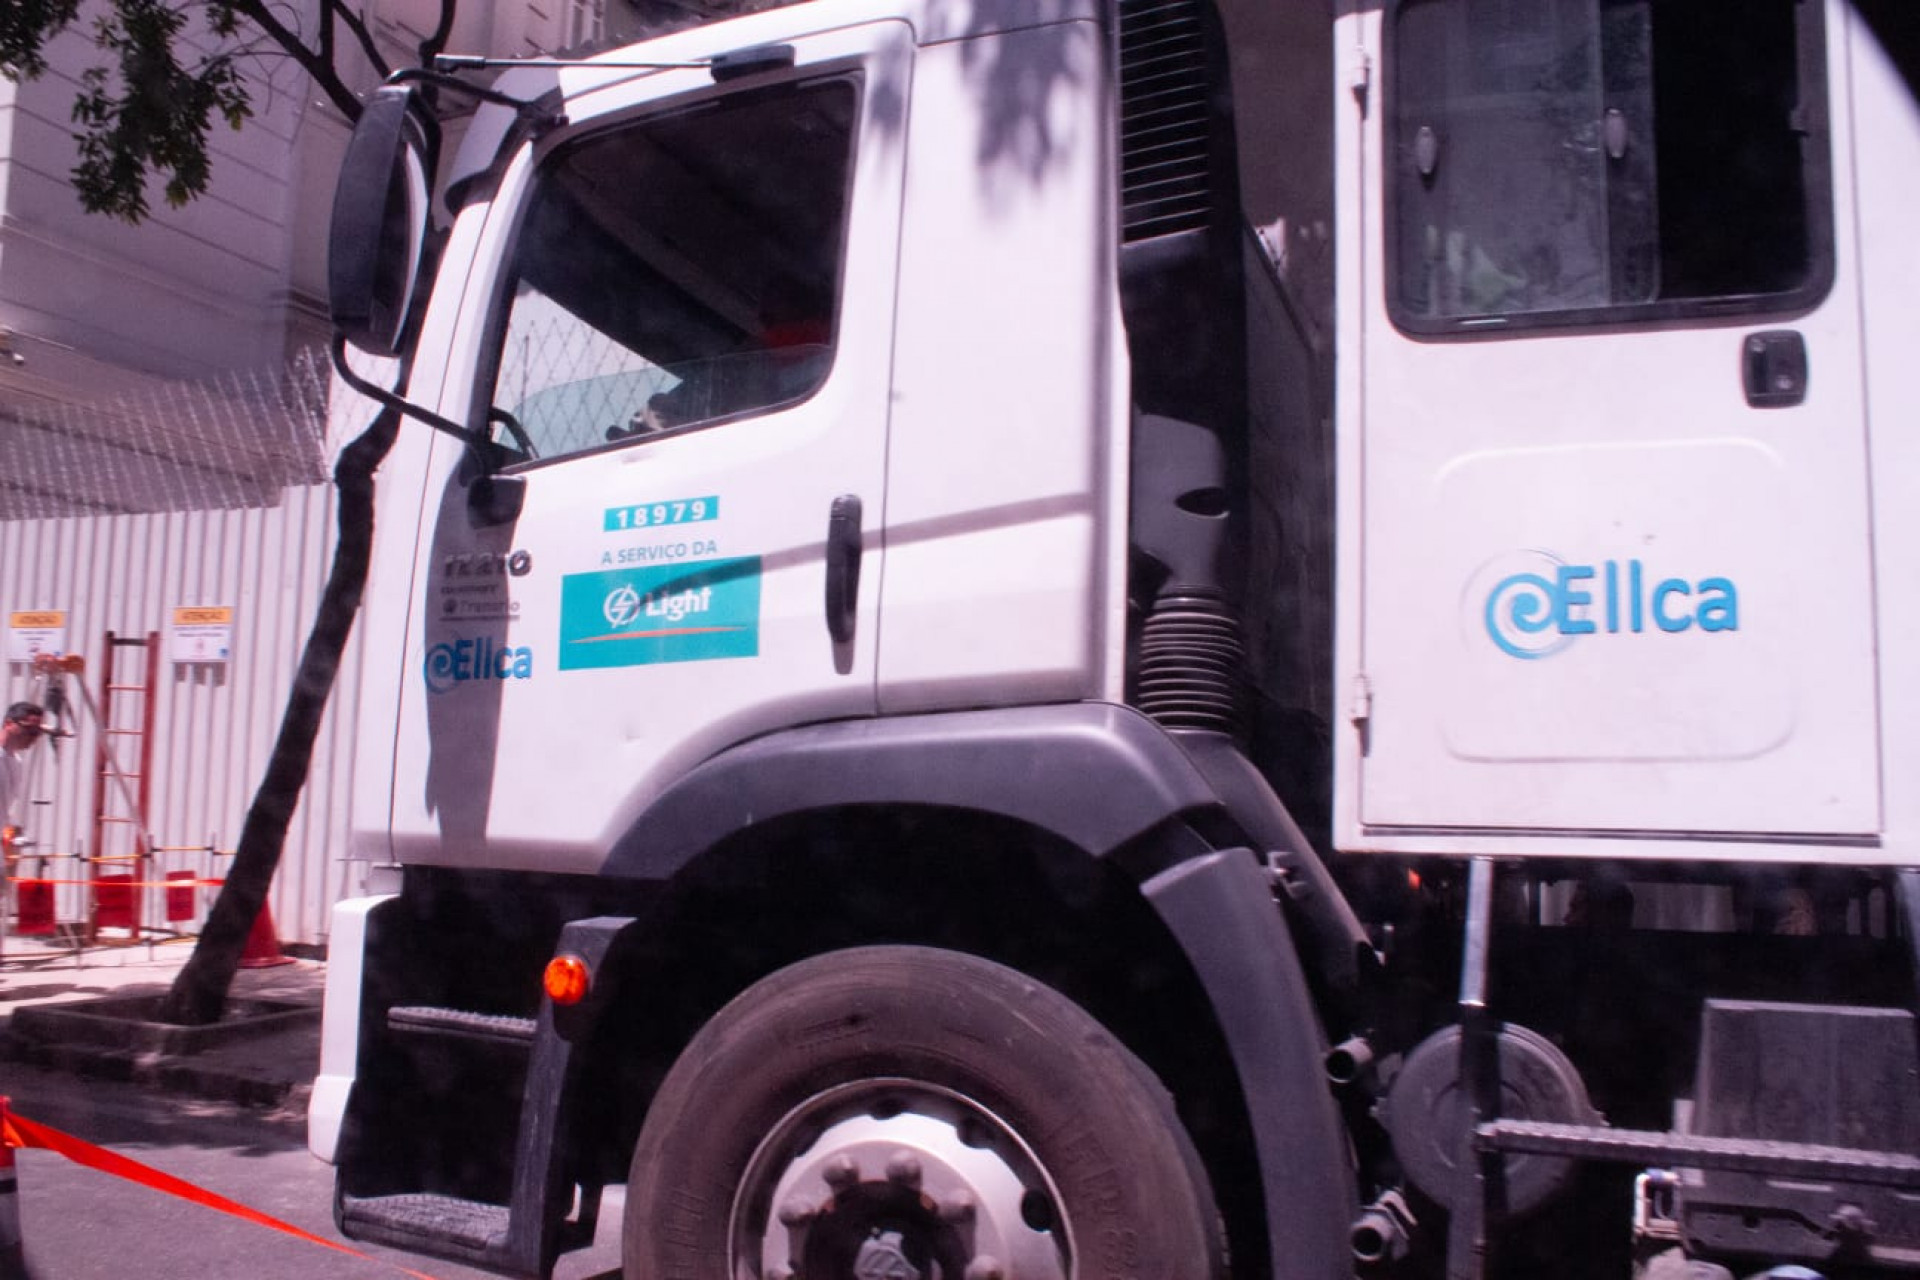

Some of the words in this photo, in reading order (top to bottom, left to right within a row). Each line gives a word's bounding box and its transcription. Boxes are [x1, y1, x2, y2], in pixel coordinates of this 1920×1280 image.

[616, 501, 706, 528] 18979
[602, 550, 613, 564] A
[692, 539, 718, 555] DA
[646, 587, 711, 621] Light
